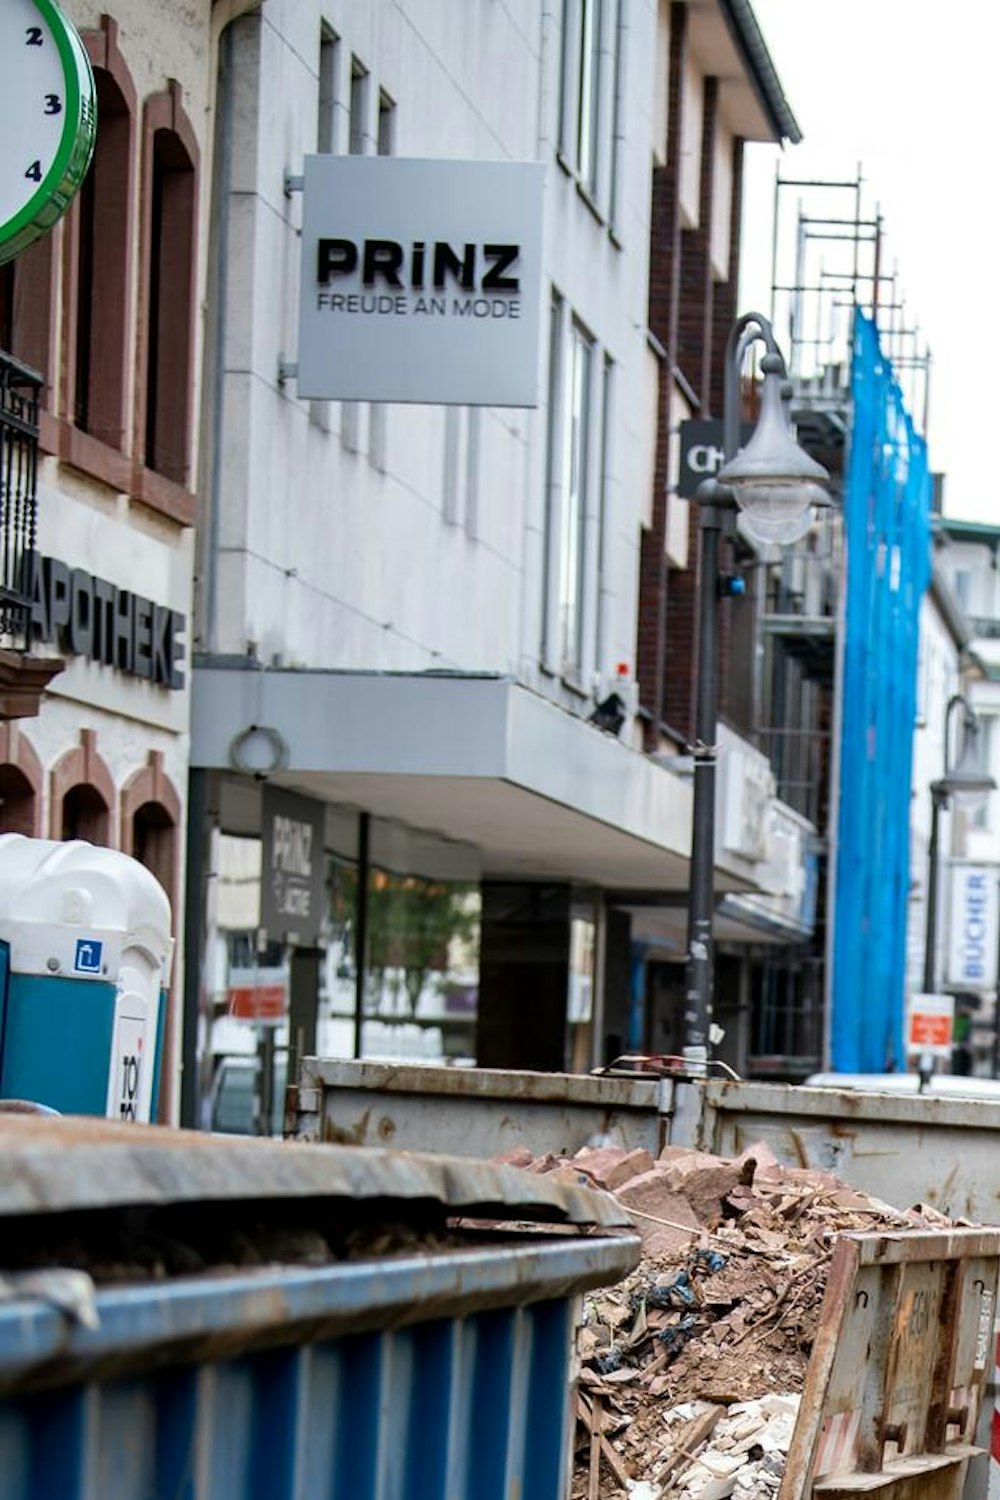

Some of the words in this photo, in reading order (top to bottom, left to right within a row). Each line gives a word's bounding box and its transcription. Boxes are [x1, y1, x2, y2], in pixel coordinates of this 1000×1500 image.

[26, 27, 43, 46] 2
[44, 94, 62, 115] 3
[25, 160, 42, 182] 4
[317, 293, 407, 314] FREUDE
[413, 297, 446, 316] AN
[453, 299, 520, 319] MODE
